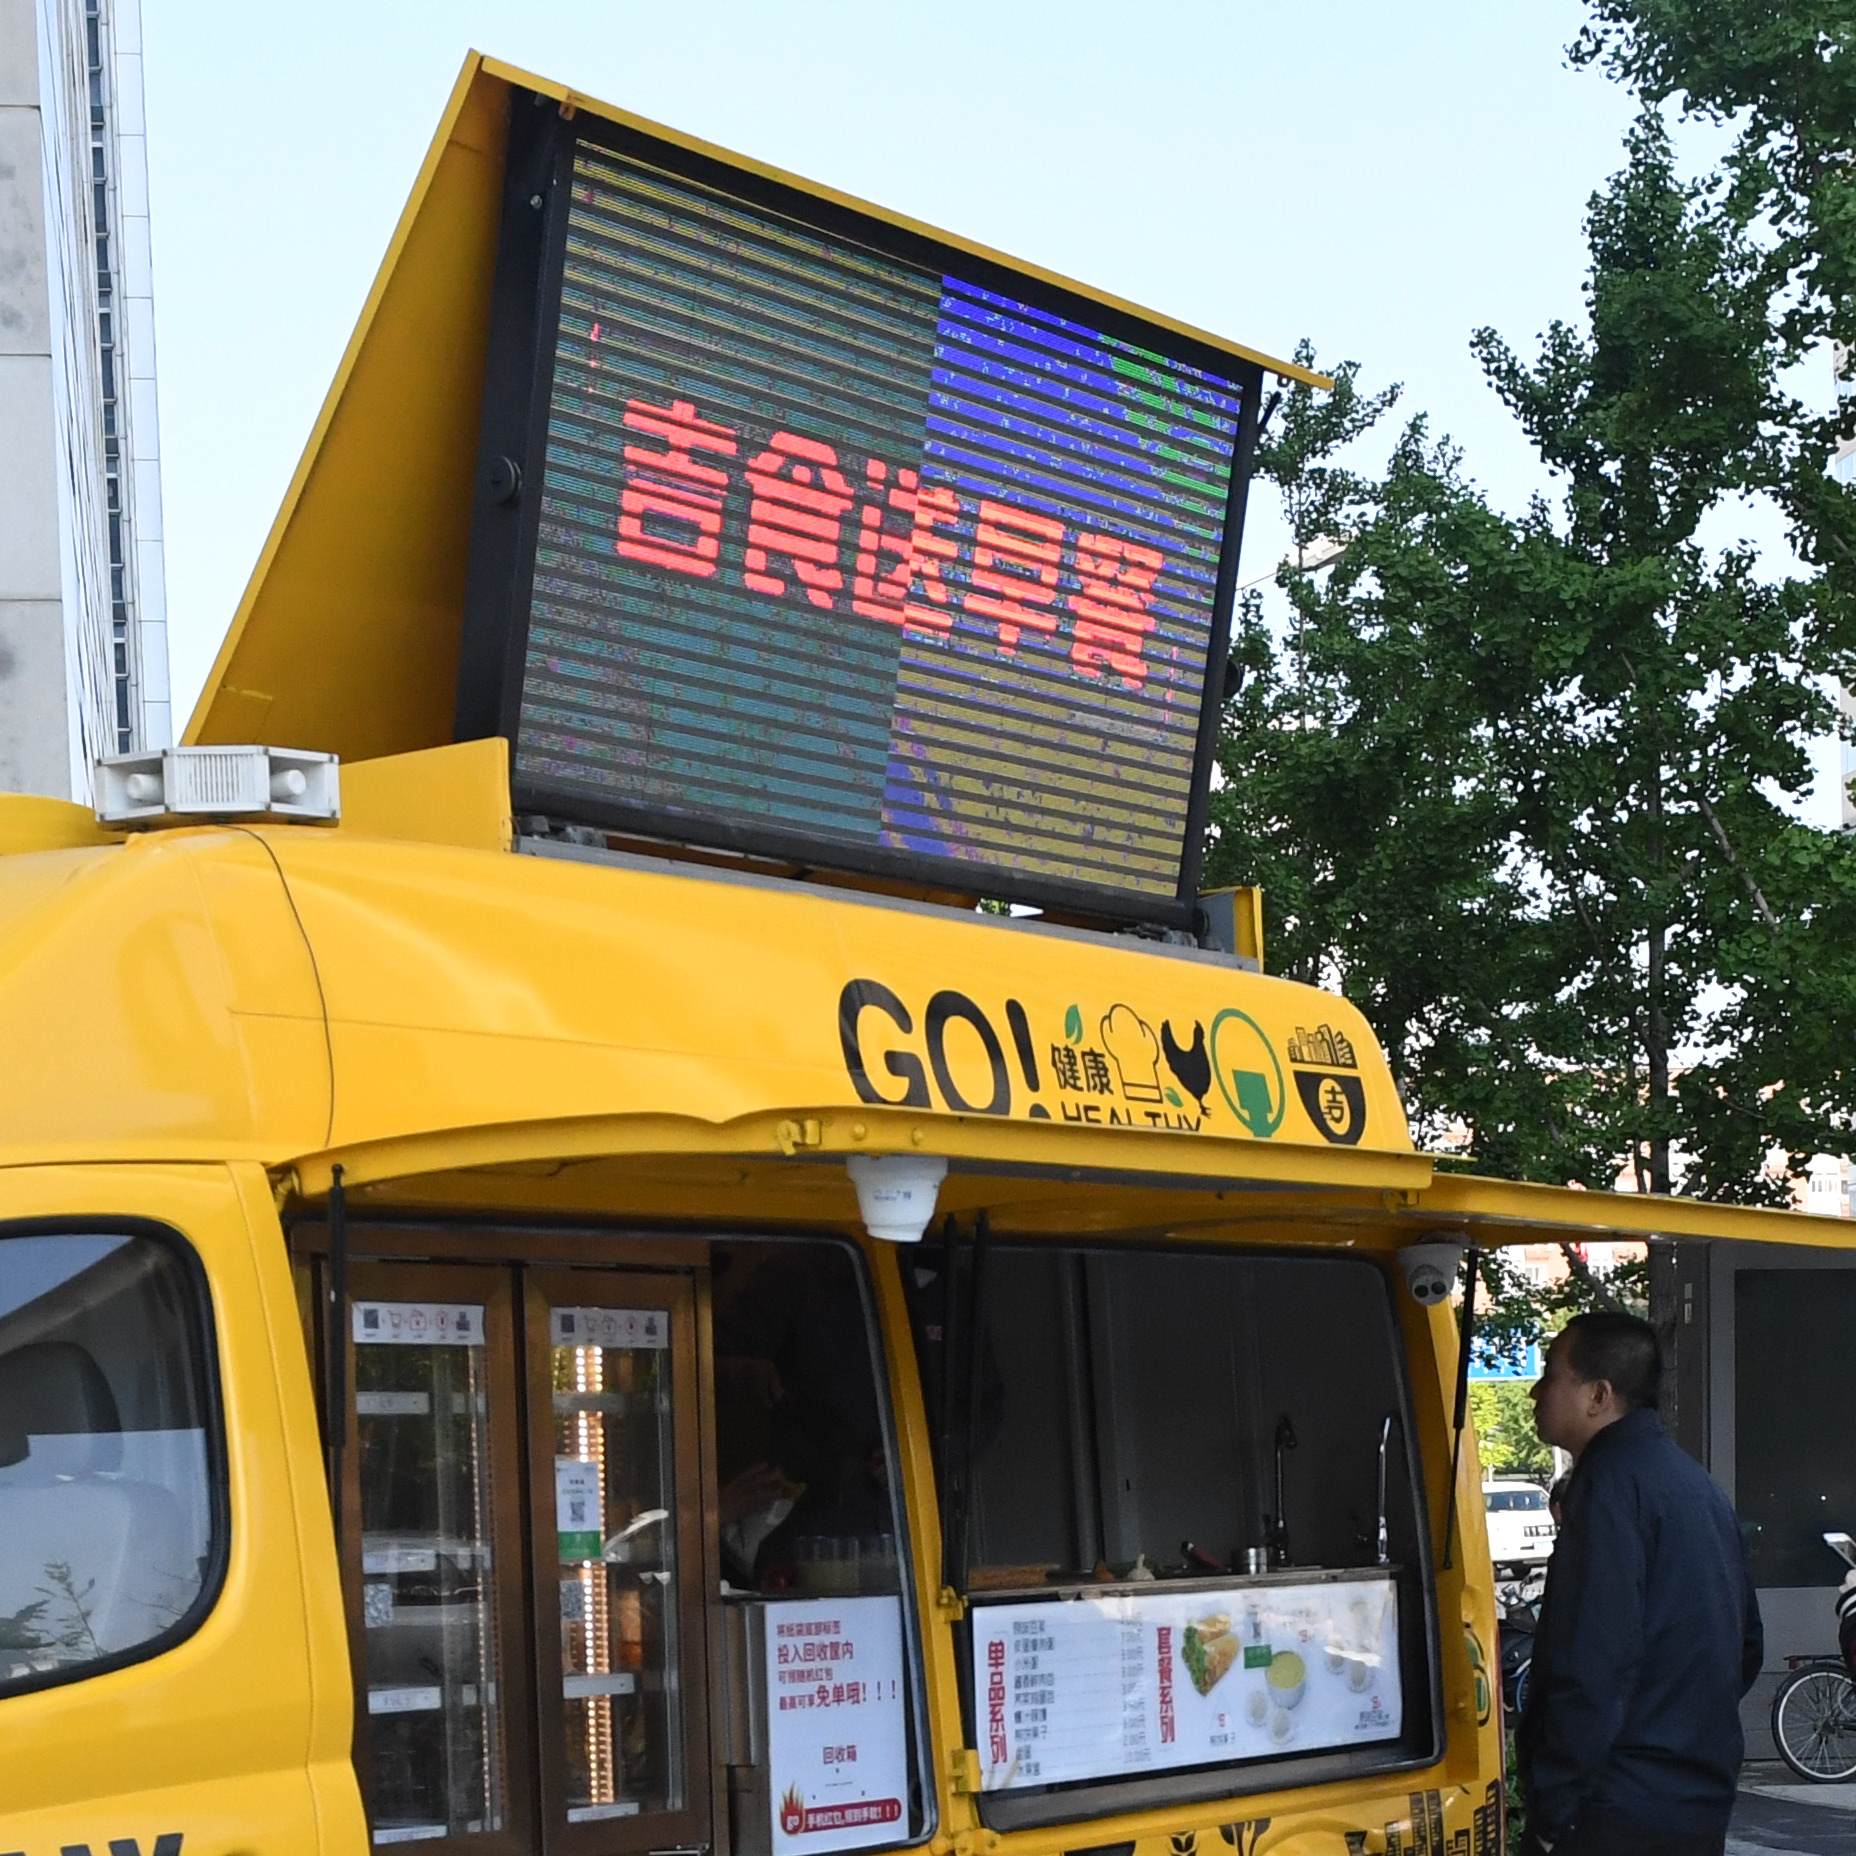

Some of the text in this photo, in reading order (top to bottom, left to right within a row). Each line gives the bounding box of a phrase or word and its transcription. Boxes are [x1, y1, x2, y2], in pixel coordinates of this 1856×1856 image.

[1051, 1043, 1115, 1096] 健康
[987, 1640, 1008, 1765] 单品系列
[1156, 1626, 1176, 1744] 套餐系列
[823, 1745, 858, 1765] 回收箱
